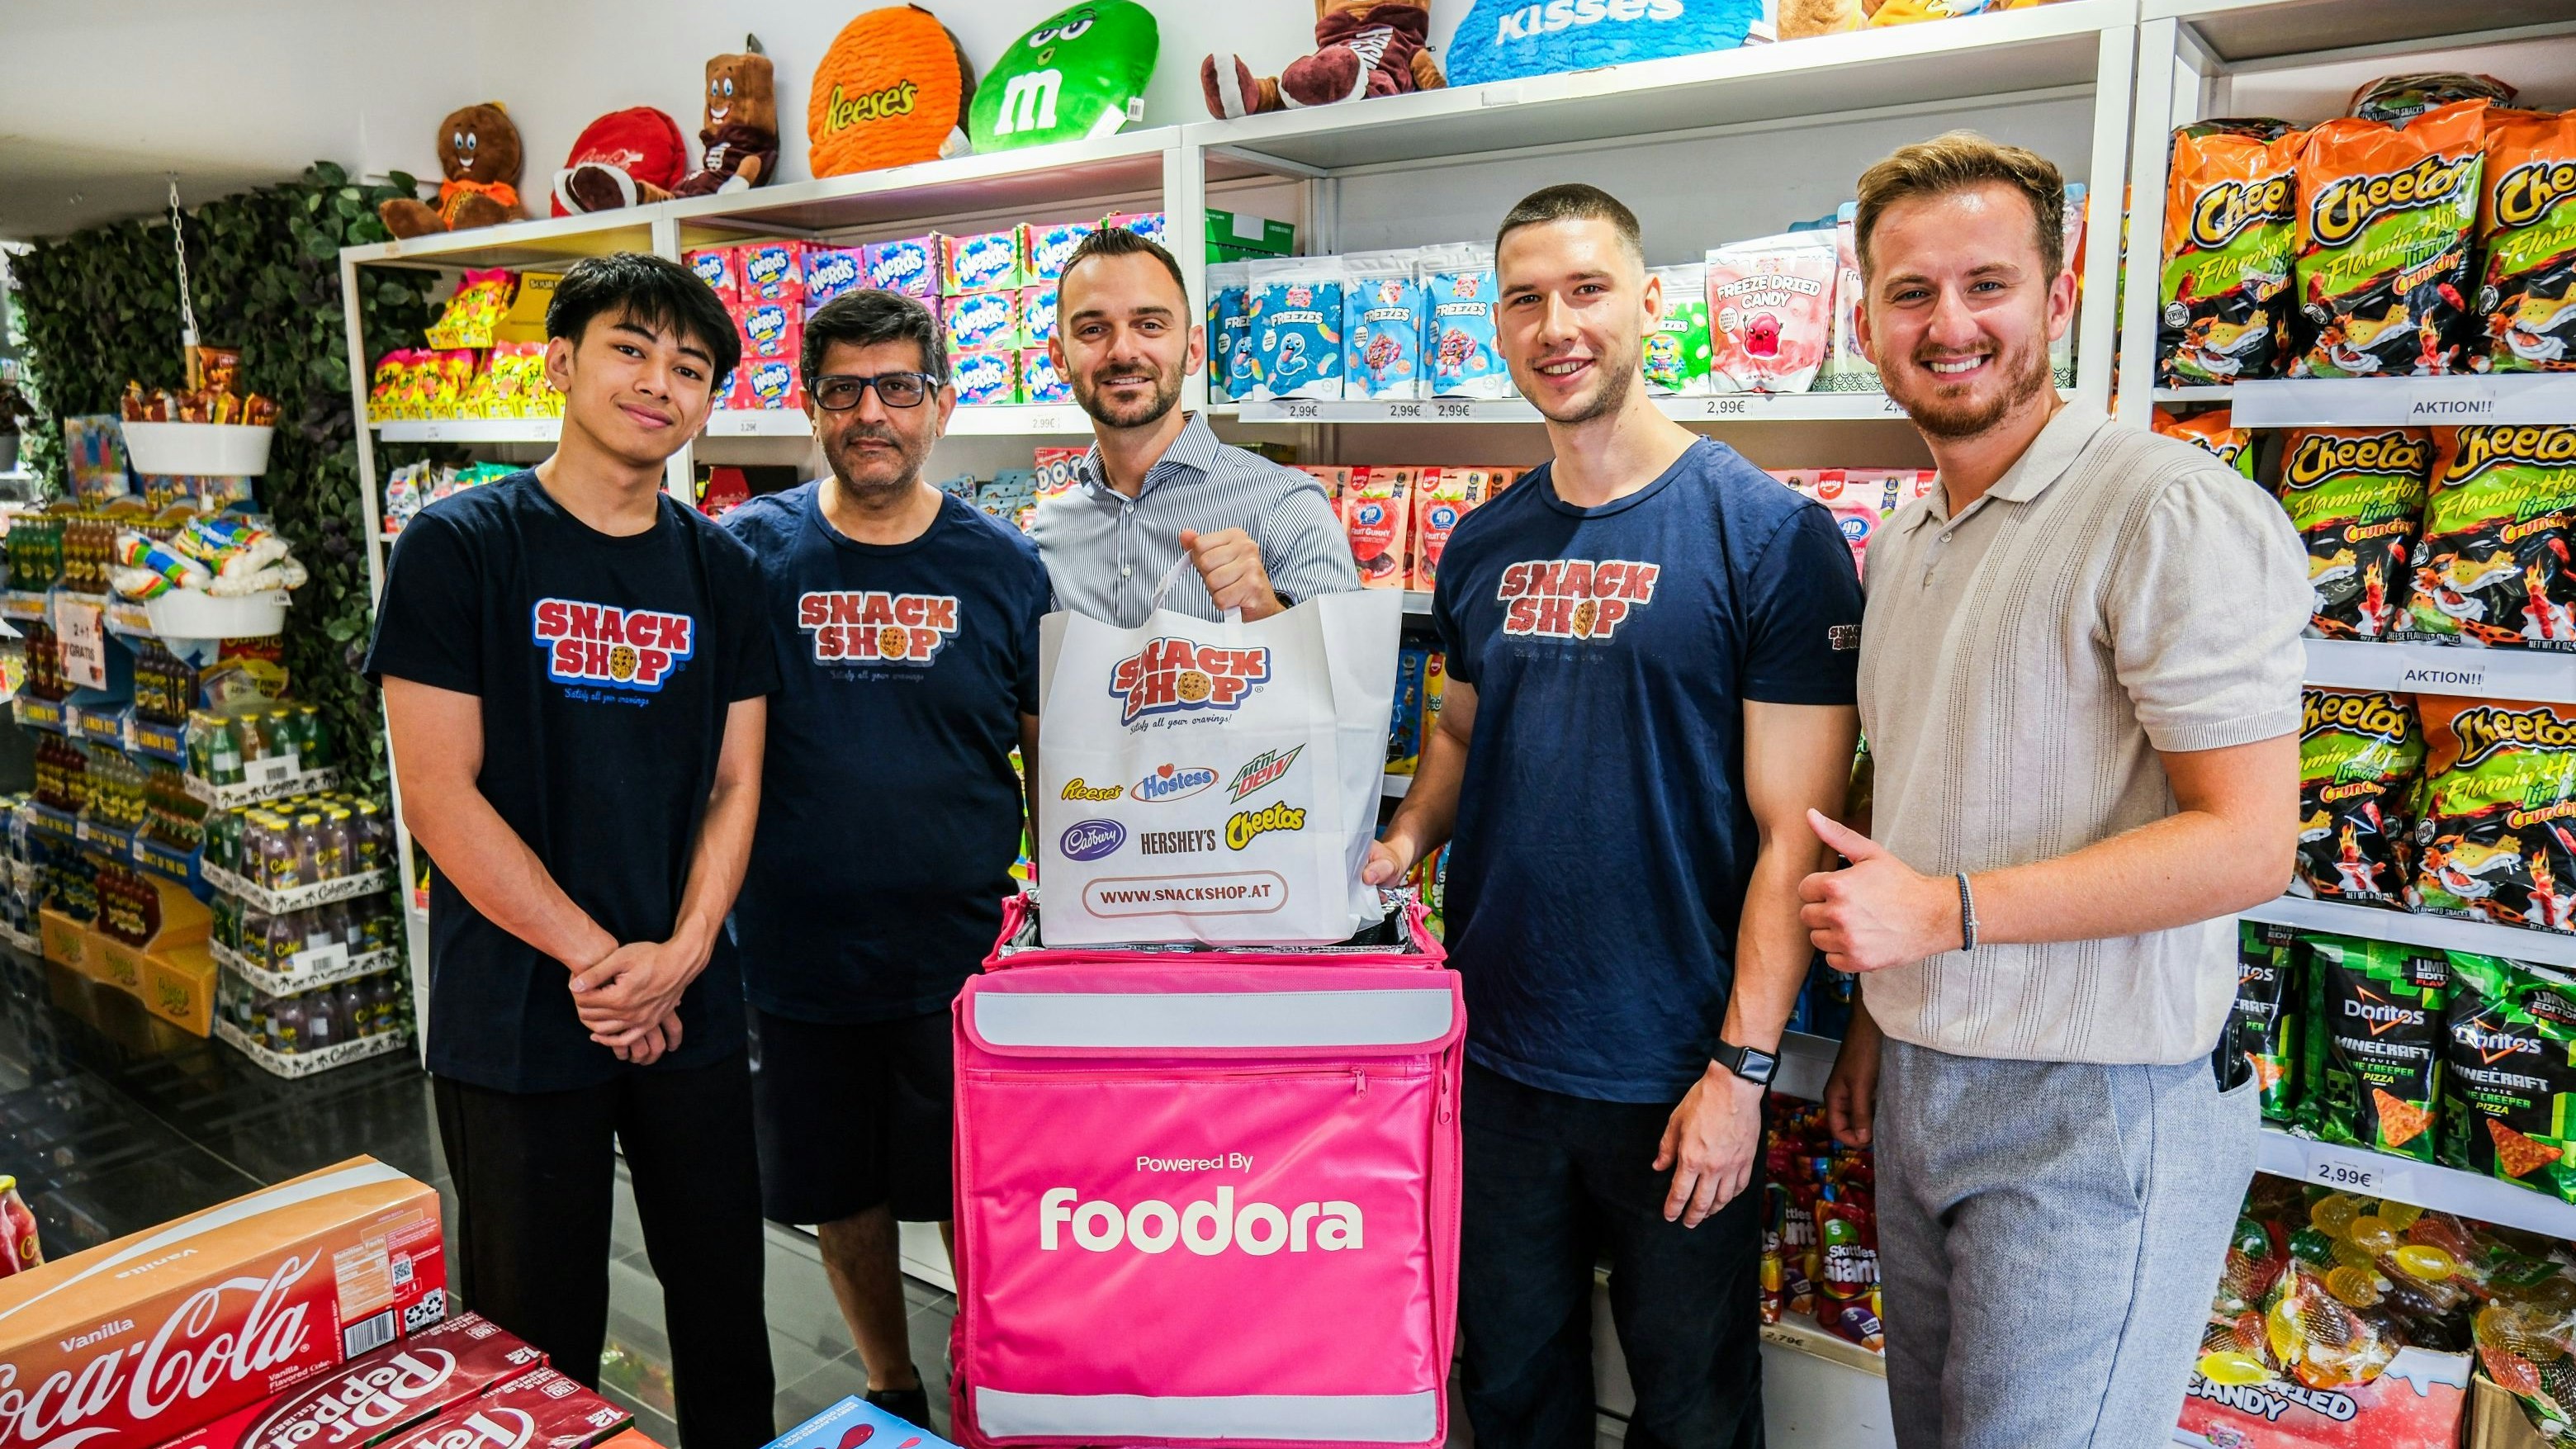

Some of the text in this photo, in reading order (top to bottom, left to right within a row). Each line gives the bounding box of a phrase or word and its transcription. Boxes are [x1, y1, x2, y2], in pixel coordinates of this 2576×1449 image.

[823, 80, 918, 138] Reese's
[994, 69, 1063, 135] m
[2400, 106, 2424, 116] SNACKS
[2421, 201, 2458, 239] Hot
[2505, 224, 2576, 270] Flam
[2393, 249, 2464, 296] Crunchy
[1716, 274, 1822, 301] FREEZE DRIED
[1435, 301, 1487, 319] FREEZES
[1740, 291, 1792, 310] CANDY
[1224, 315, 1252, 329] FREE
[1270, 310, 1324, 327] FREEZES
[1363, 307, 1410, 325] FREEZES
[1290, 405, 1318, 418] 2,99€
[1390, 405, 1421, 418] 2,99€
[1438, 405, 1470, 418] 2,99€
[1707, 400, 1745, 414] 2,99€
[2413, 400, 2493, 414] AKTION!!
[2290, 434, 2424, 485] Cheetos
[2446, 425, 2576, 480] Cheeto
[1037, 457, 1082, 491] DOT
[2294, 476, 2424, 522] Flamin' Hot
[2436, 469, 2576, 528] Flamin' Ho
[2358, 500, 2412, 527] Limón
[1842, 520, 1862, 534] 4D
[2344, 518, 2417, 544] Crunchy
[1501, 562, 1659, 600] SNACK
[801, 594, 954, 630] SNACK
[1507, 598, 1627, 637] SHOP
[537, 601, 688, 651] SNACK
[818, 626, 938, 658] SHOP
[2436, 633, 2460, 644] SNACKS
[2529, 641, 2541, 650] NET
[2542, 642, 2554, 650] WT.
[69, 643, 95, 661] GRATIS
[555, 638, 669, 682] SHOP
[1116, 639, 1267, 689] SNACK
[2404, 669, 2483, 685] AKTION!!
[590, 690, 601, 700] all
[1126, 670, 1245, 718] SHOP
[1152, 716, 1165, 729] all
[1167, 717, 1189, 730] your
[1191, 713, 1233, 727] cravings!
[1061, 778, 1124, 802] Reese's
[1143, 769, 1212, 801] Hostess
[2320, 780, 2386, 803] Crunchy
[2446, 764, 2538, 808] Flamin'
[1226, 801, 1306, 850] Cheetos
[1068, 826, 1117, 854] Cadbury
[1141, 829, 1216, 855] HERSHEY'S
[1100, 883, 1271, 904] WWW.SNACKSHOP.AT
[2346, 891, 2357, 900] NET
[2444, 909, 2469, 918] SNACKS
[2239, 963, 2274, 982] itos
[2415, 979, 2446, 987] FLAV
[2233, 998, 2280, 1014] CRAFT
[2344, 999, 2425, 1025] Doritos
[2335, 1035, 2432, 1059] MINECRAFT
[2456, 1025, 2542, 1055] Doritos
[2362, 1057, 2398, 1066] MOVIE
[2366, 1063, 2416, 1077] CREEPER
[2362, 1072, 2395, 1085] PIZZA
[2451, 1065, 2550, 1093] MINECRAFT
[2474, 1085, 2513, 1096] MOVIE
[2480, 1091, 2531, 1109] CREEPER
[2475, 1101, 2510, 1115] PIZZA
[1136, 1152, 1254, 1174] Powered By
[2318, 1163, 2372, 1188] 2,99€
[1039, 1185, 1364, 1257] foodora
[1786, 1207, 1811, 1221] ttles
[1829, 1243, 1877, 1260] Skittles
[114, 1248, 199, 1281] Vanilla
[59, 1316, 135, 1354] Vanilla
[0, 1247, 323, 1449] oca-Cola
[504, 1346, 526, 1361] PACK
[513, 1346, 542, 1366] 12
[268, 1363, 300, 1382] Vanilla
[269, 1369, 309, 1390] Flavored
[552, 1384, 575, 1397] 150
[329, 1390, 409, 1444] Dr
[585, 1408, 607, 1423] PACK
[594, 1406, 625, 1428] 12
